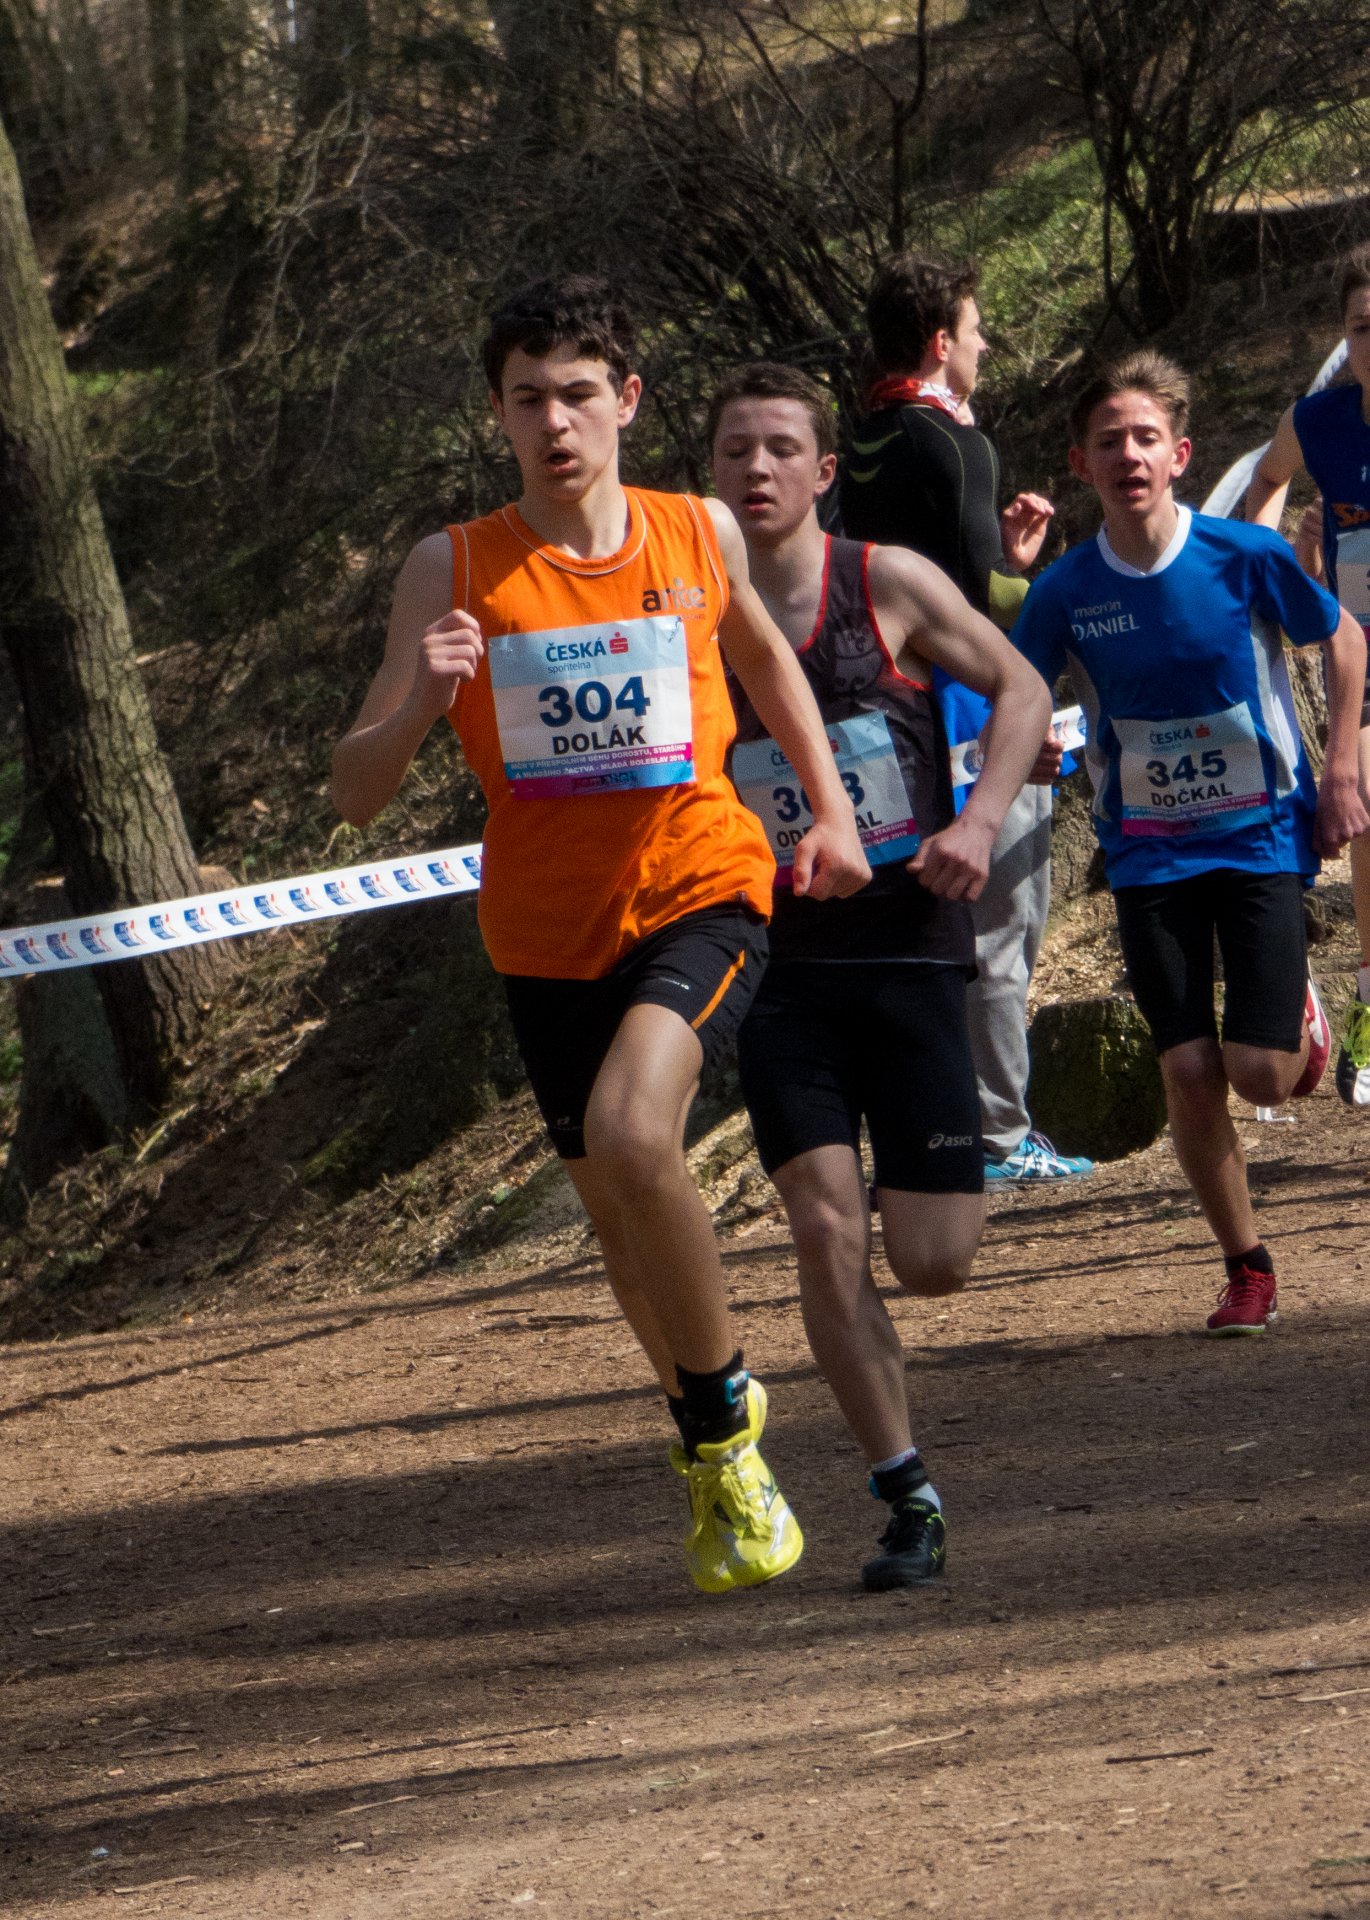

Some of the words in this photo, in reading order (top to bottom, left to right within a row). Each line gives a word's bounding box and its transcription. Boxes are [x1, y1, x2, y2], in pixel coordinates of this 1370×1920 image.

[1071, 613, 1140, 641] DANIEL
[545, 636, 607, 662] ČESKÁ
[547, 661, 592, 675] spořitelna
[538, 676, 651, 728] 304
[552, 724, 647, 755] DOLÁK
[629, 756, 669, 767] BOLESLAV
[1146, 749, 1227, 788] 345
[1151, 783, 1233, 808] DOČKAL
